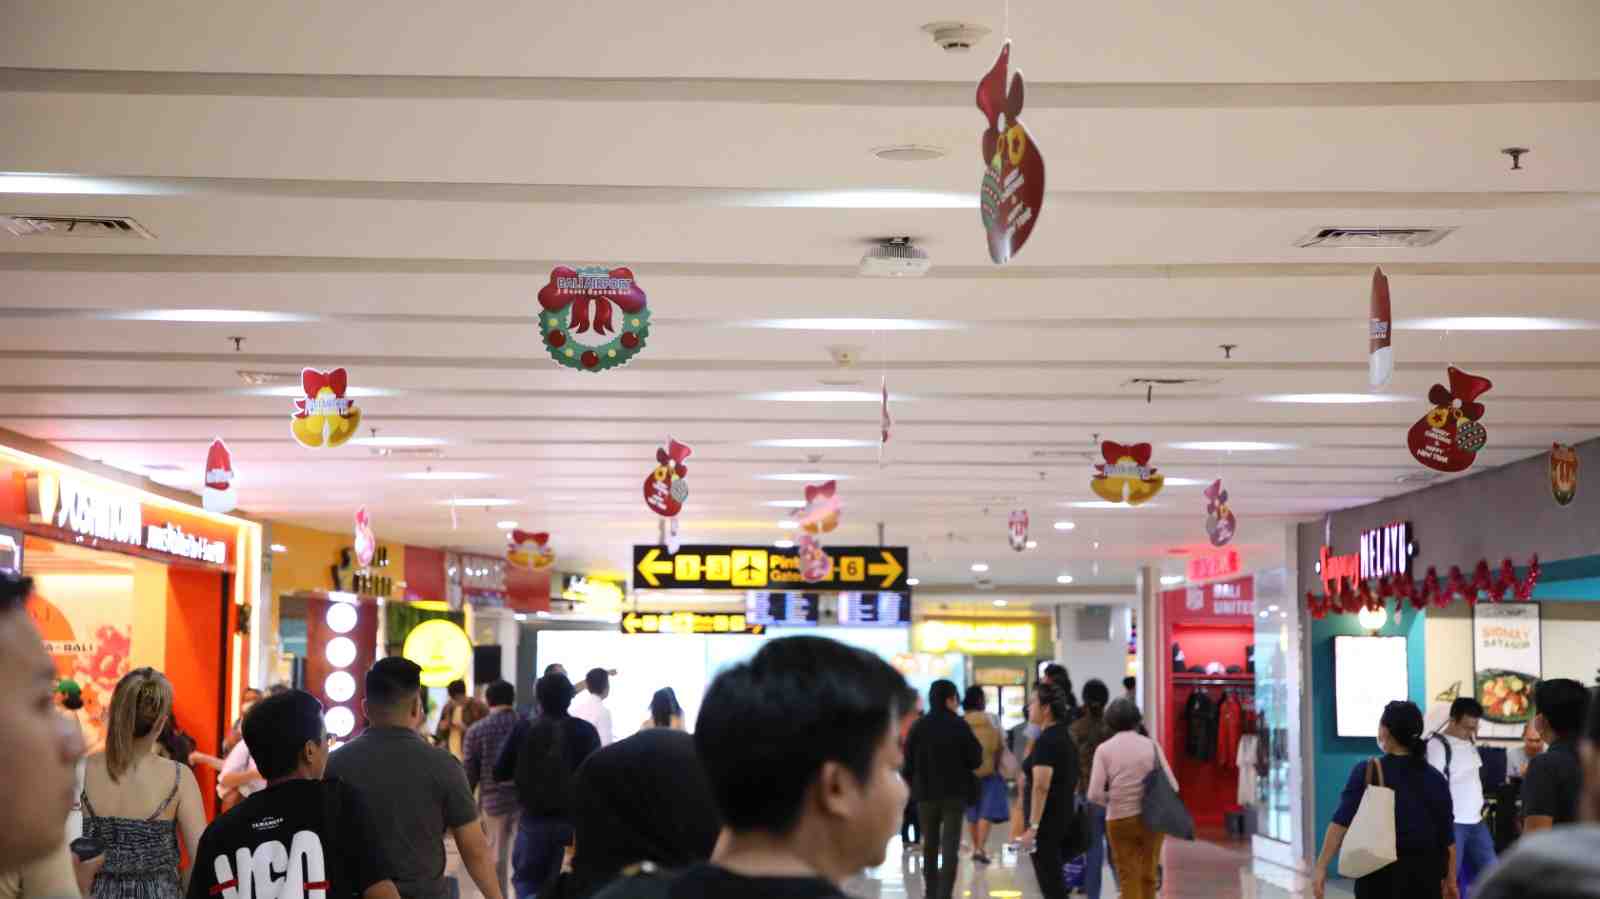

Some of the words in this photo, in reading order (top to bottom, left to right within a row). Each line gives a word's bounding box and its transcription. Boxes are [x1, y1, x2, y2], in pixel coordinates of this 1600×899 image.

[557, 277, 583, 289] BALI
[583, 277, 631, 289] AIRPORT
[1360, 523, 1406, 580] MELAYU
